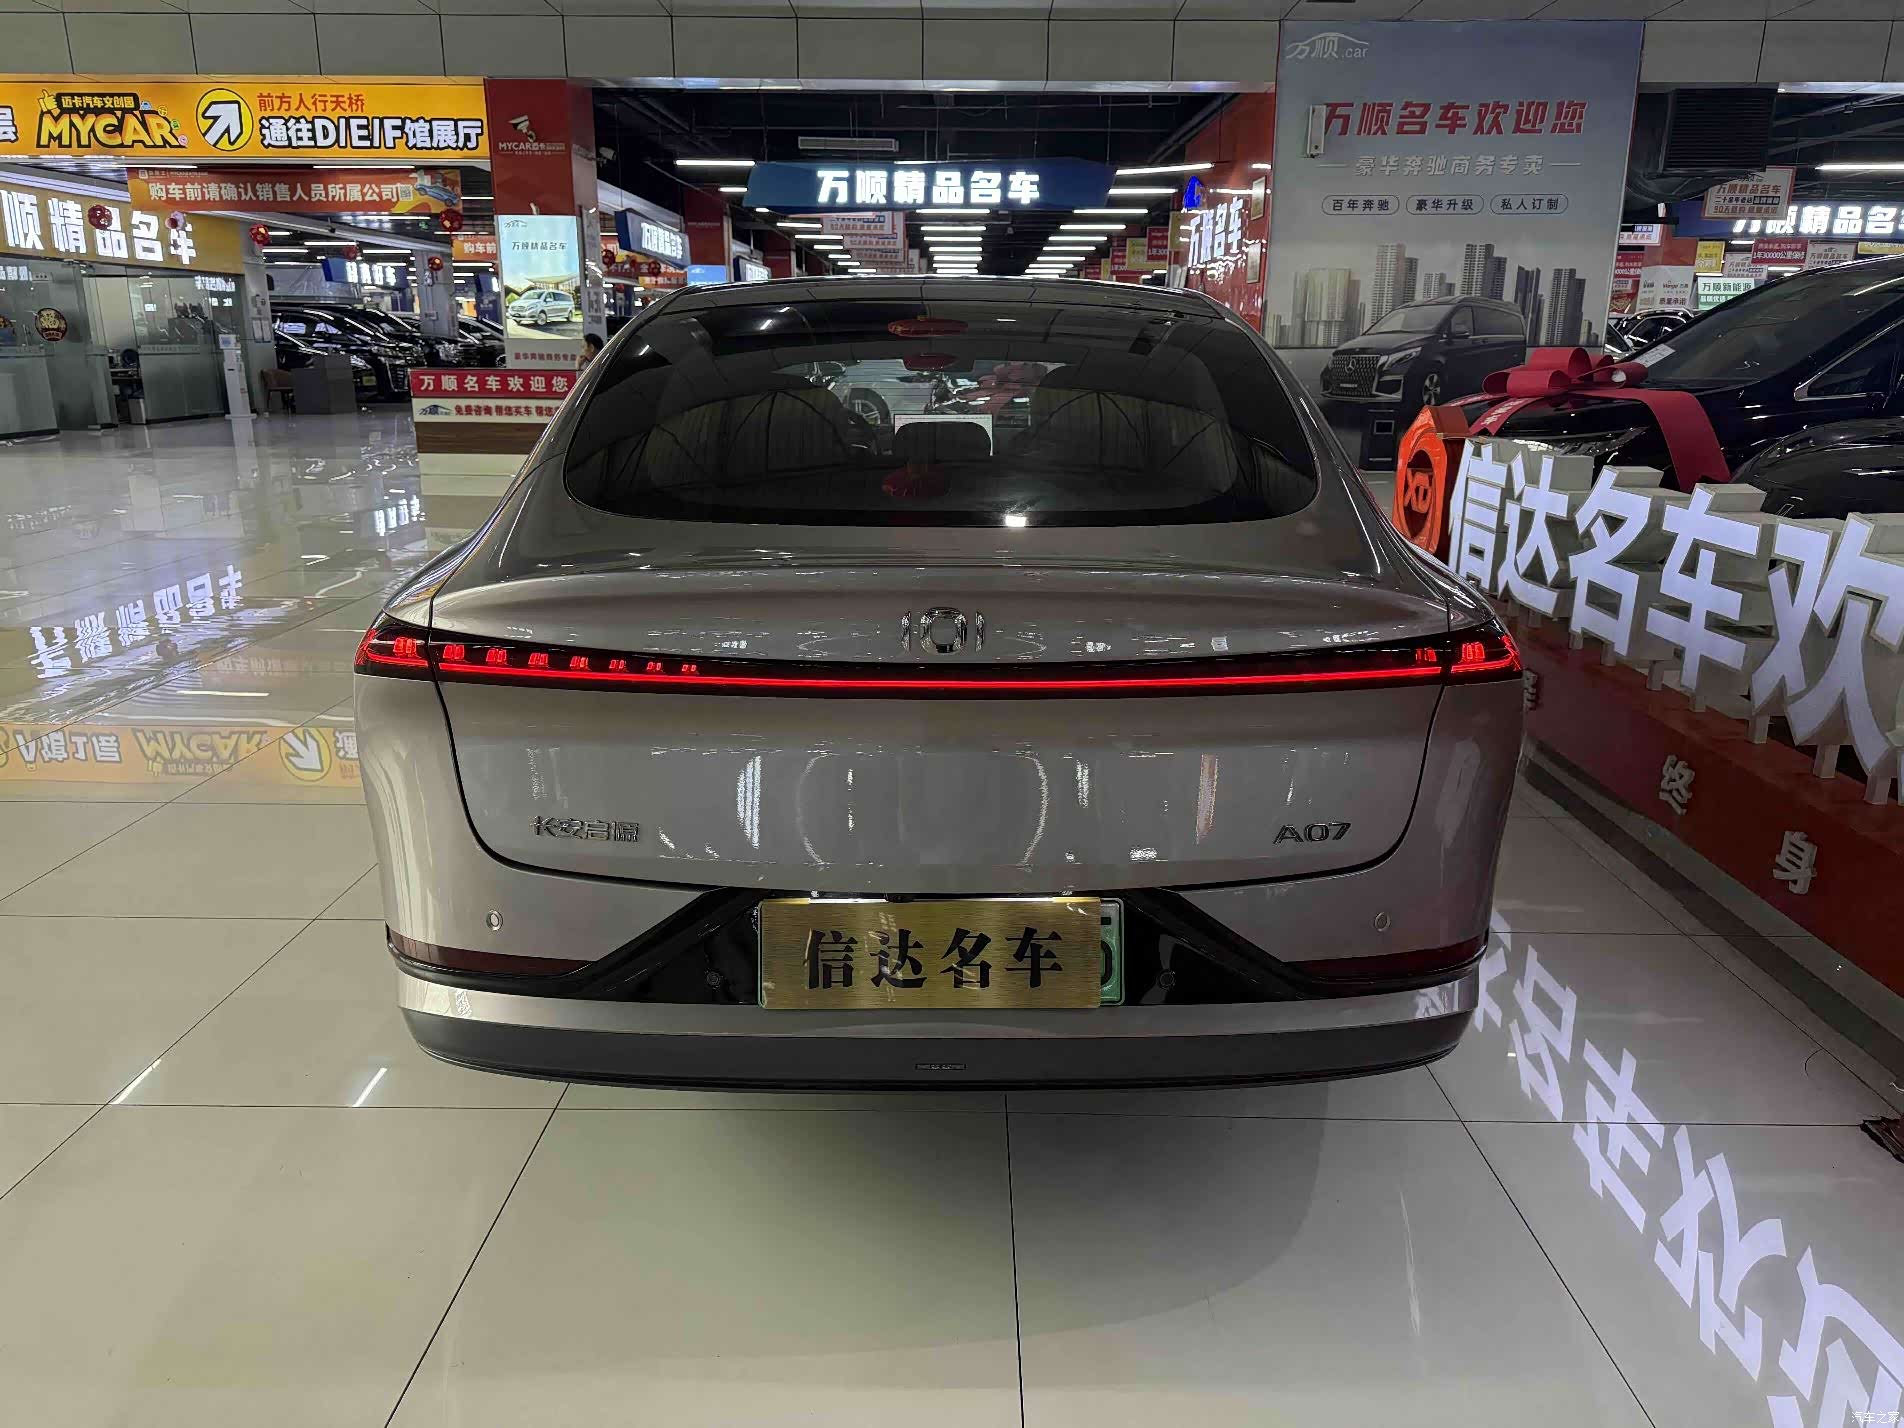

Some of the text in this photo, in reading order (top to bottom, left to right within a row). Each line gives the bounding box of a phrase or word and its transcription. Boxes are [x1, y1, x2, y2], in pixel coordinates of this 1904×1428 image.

[61, 95, 135, 109] 迈卡汽车文创园
[257, 93, 365, 113] 前方人行天桥
[38, 112, 181, 147] MYCAR
[1322, 101, 1589, 137] 万顺名车欢迎您
[1353, 154, 1545, 177] 豪华奔驰商务专卖
[149, 182, 399, 202] 购车前请确认销售人员所属公司
[815, 169, 1041, 205] 万顺精品名车
[1715, 183, 1782, 195] 万顺精品名车
[1331, 197, 1560, 212] 百年奔驰 豪华升级 私人订制
[1732, 205, 1904, 234] 顺精品名
[419, 374, 570, 393] 万顺名车欢迎您
[535, 405, 562, 417] 帮您
[1449, 436, 1904, 806] 信达名车欢
[1272, 822, 1352, 845] A07
[802, 926, 1063, 990] 信达名车
